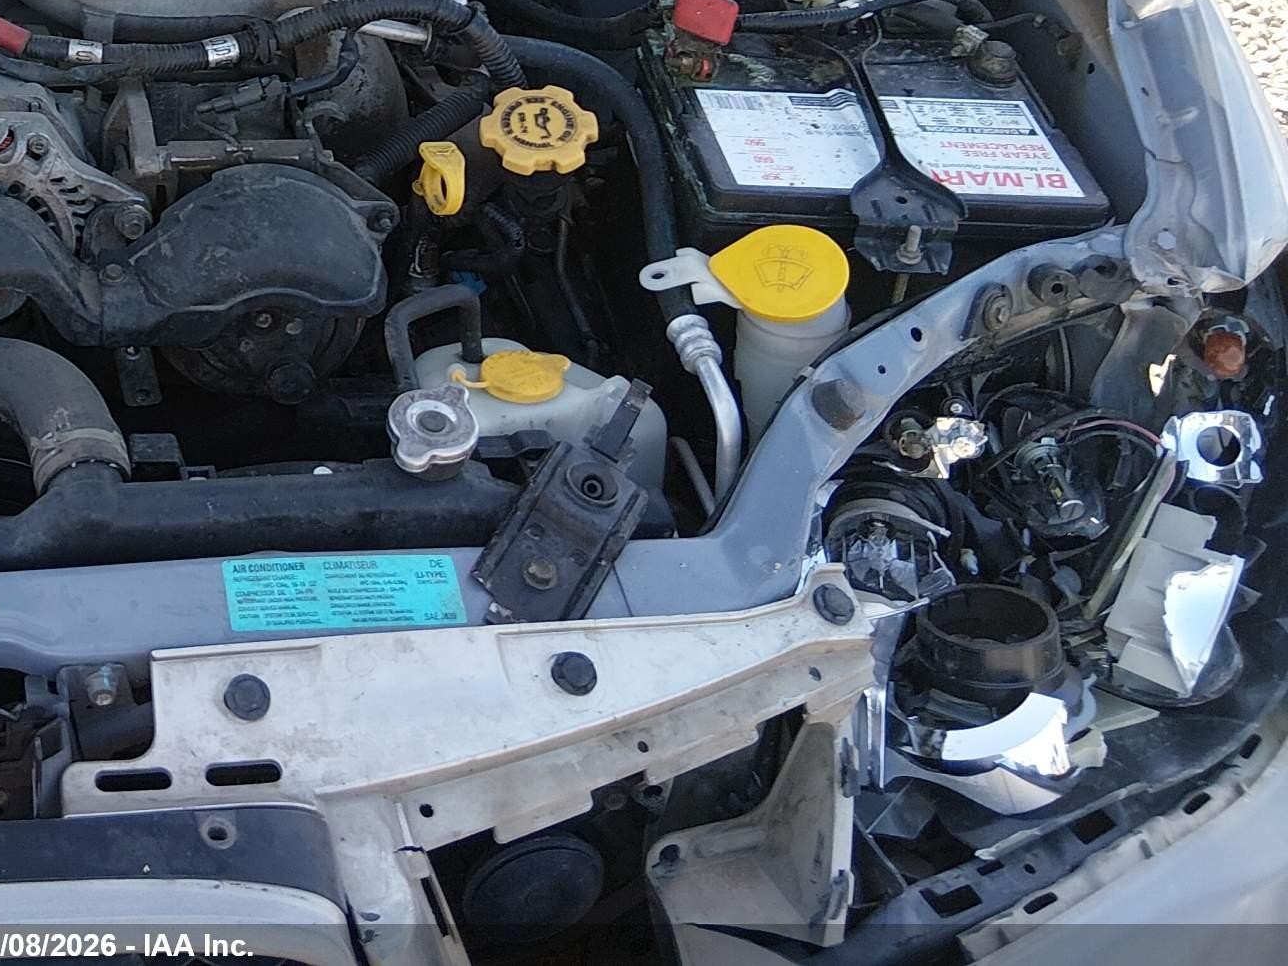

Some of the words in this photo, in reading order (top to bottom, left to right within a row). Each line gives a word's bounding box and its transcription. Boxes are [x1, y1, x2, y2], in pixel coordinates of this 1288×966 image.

[939, 141, 1047, 152] REPLACEMENT
[232, 564, 247, 574] AIR
[248, 562, 306, 573] CONDITIONER
